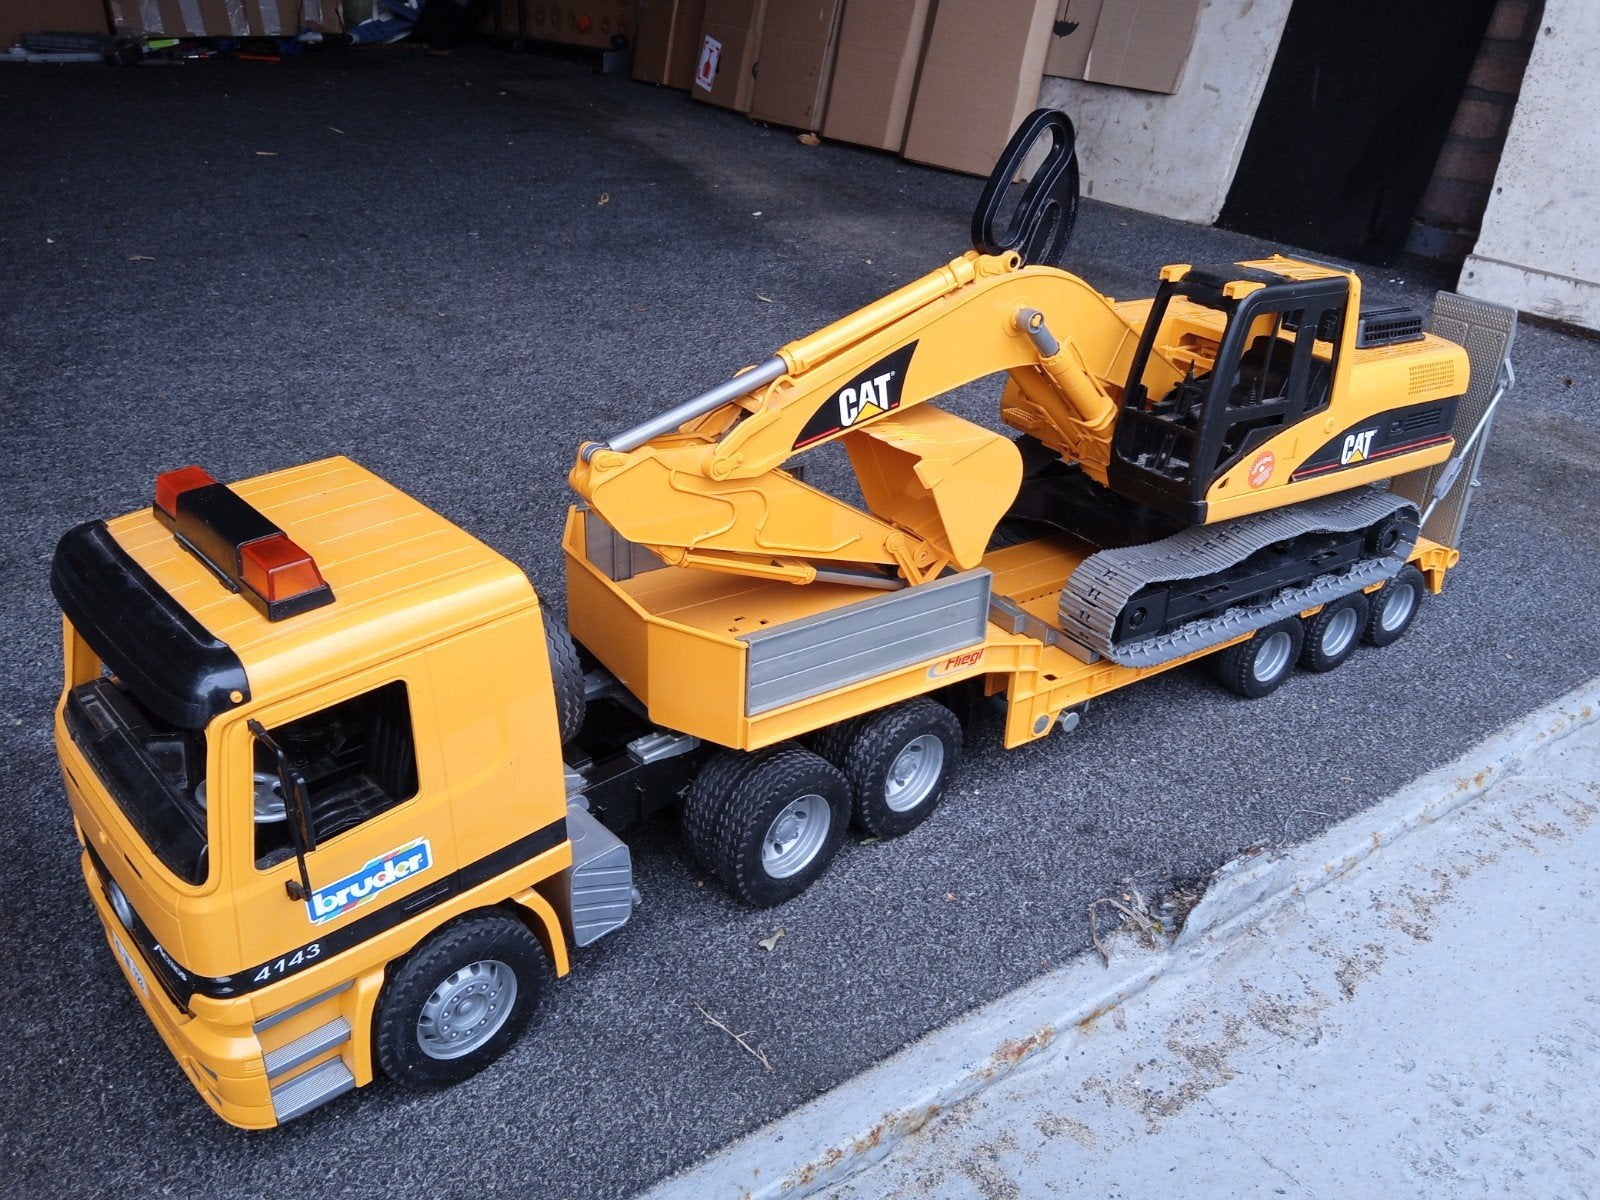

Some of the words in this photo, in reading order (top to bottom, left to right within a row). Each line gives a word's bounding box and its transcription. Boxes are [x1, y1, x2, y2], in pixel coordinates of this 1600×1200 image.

[839, 372, 891, 427] CAT
[1341, 430, 1376, 465] CAT
[944, 648, 985, 670] Fliegl
[312, 853, 422, 917] bruder
[253, 943, 320, 982] 4143
